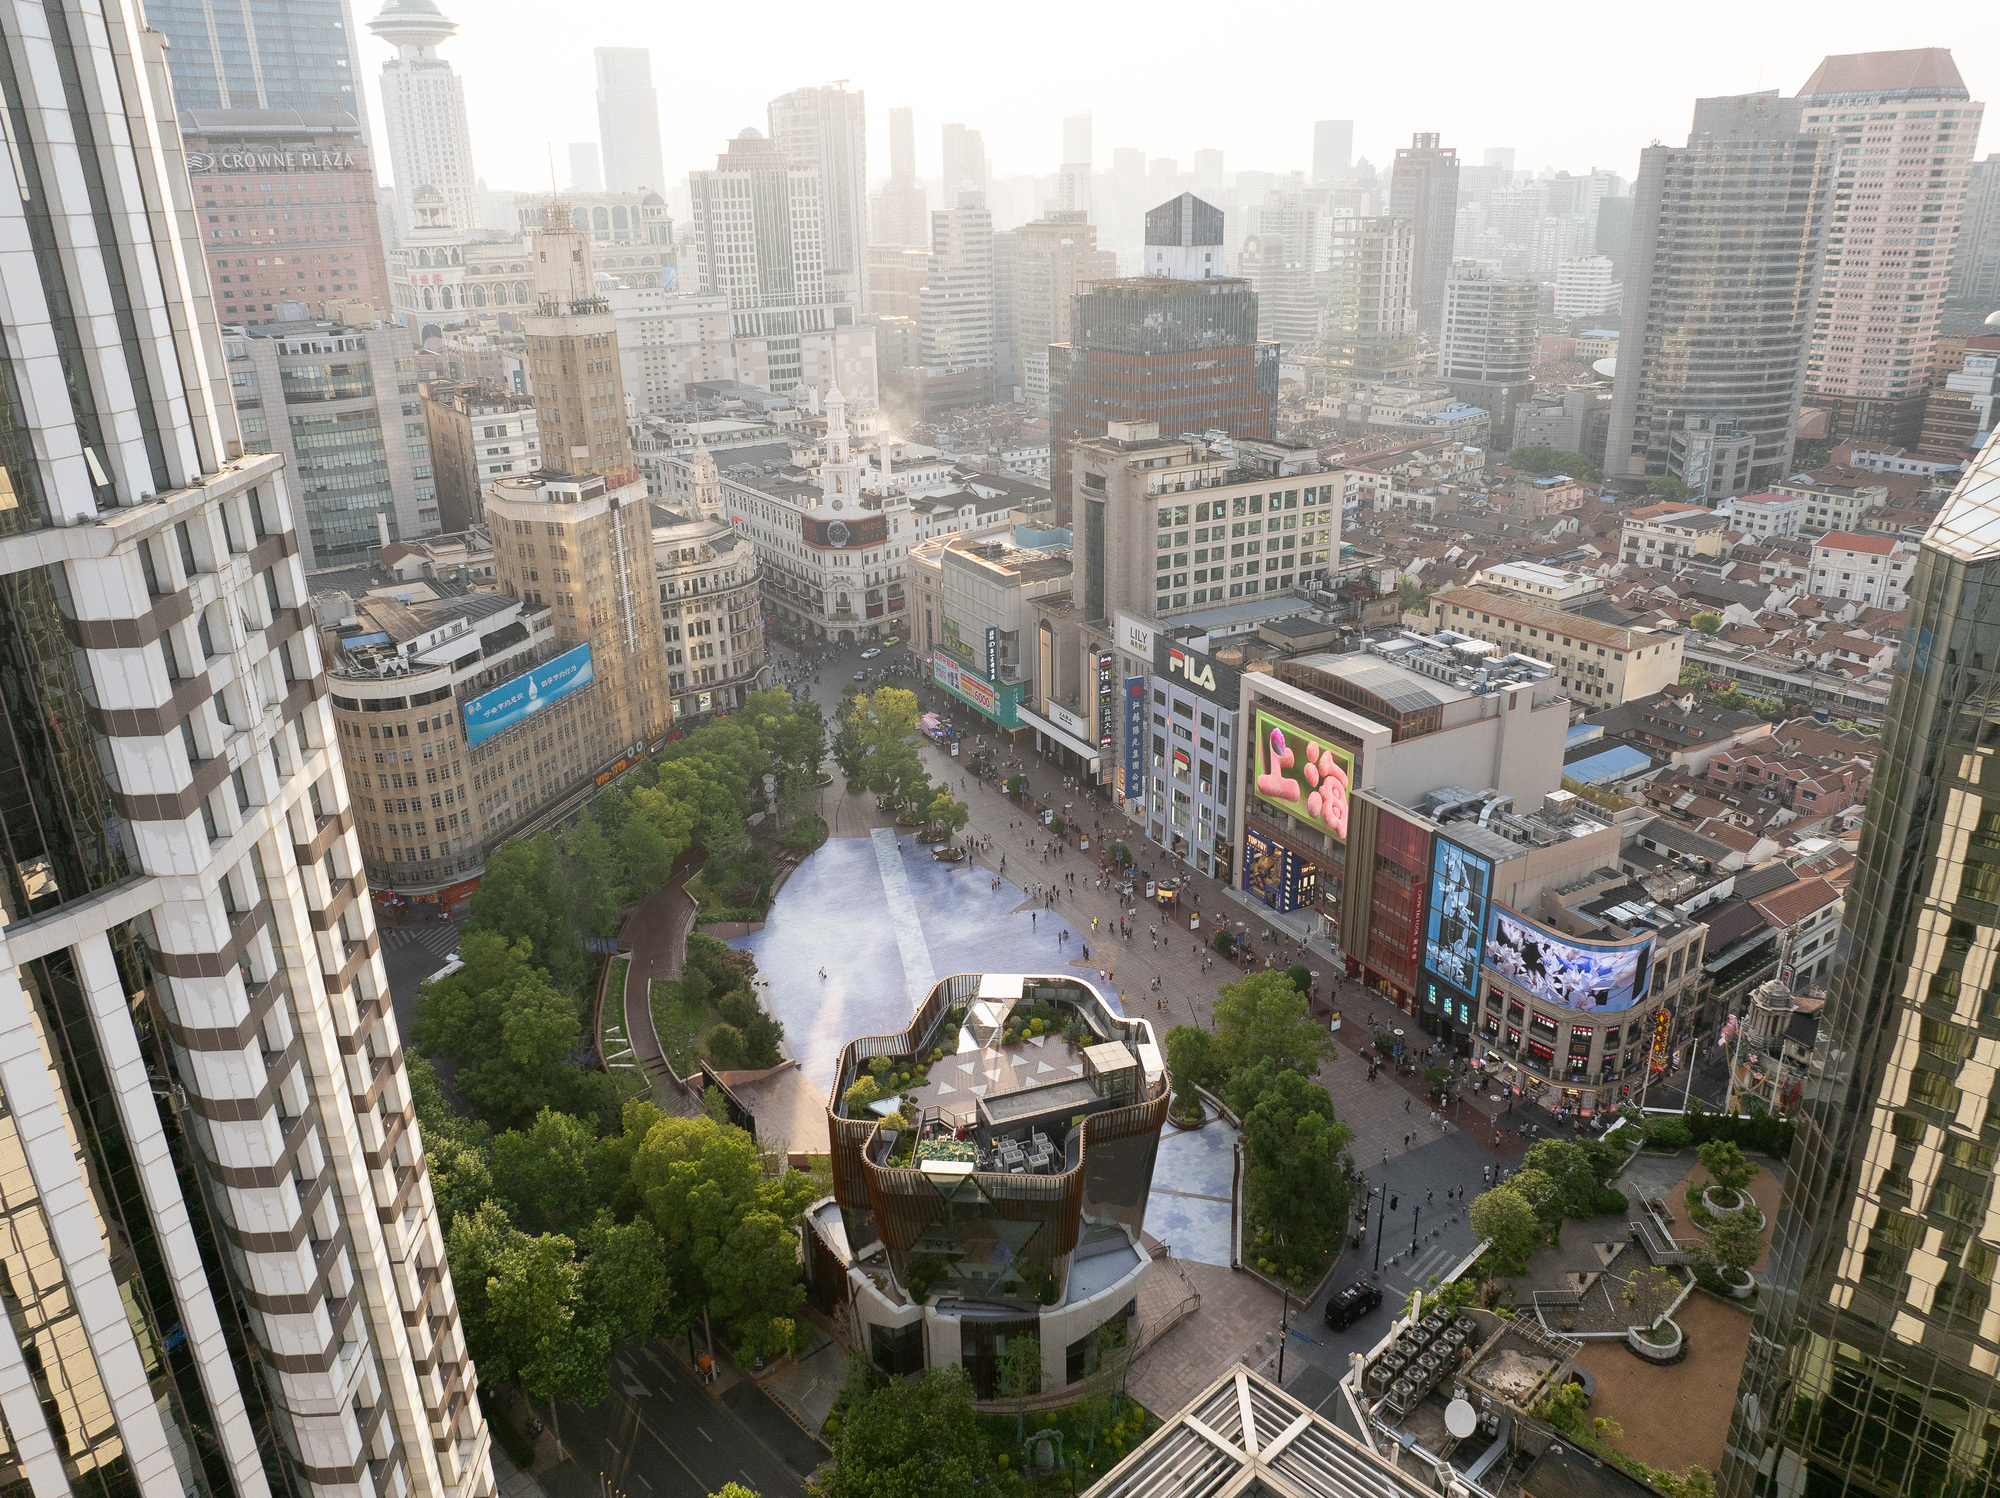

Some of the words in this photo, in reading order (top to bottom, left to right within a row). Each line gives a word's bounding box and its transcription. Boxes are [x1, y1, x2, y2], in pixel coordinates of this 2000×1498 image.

[221, 154, 295, 169] CROWNE
[302, 152, 354, 167] PLAZA
[1130, 626, 1148, 644] LILY
[1169, 648, 1216, 692] FILA
